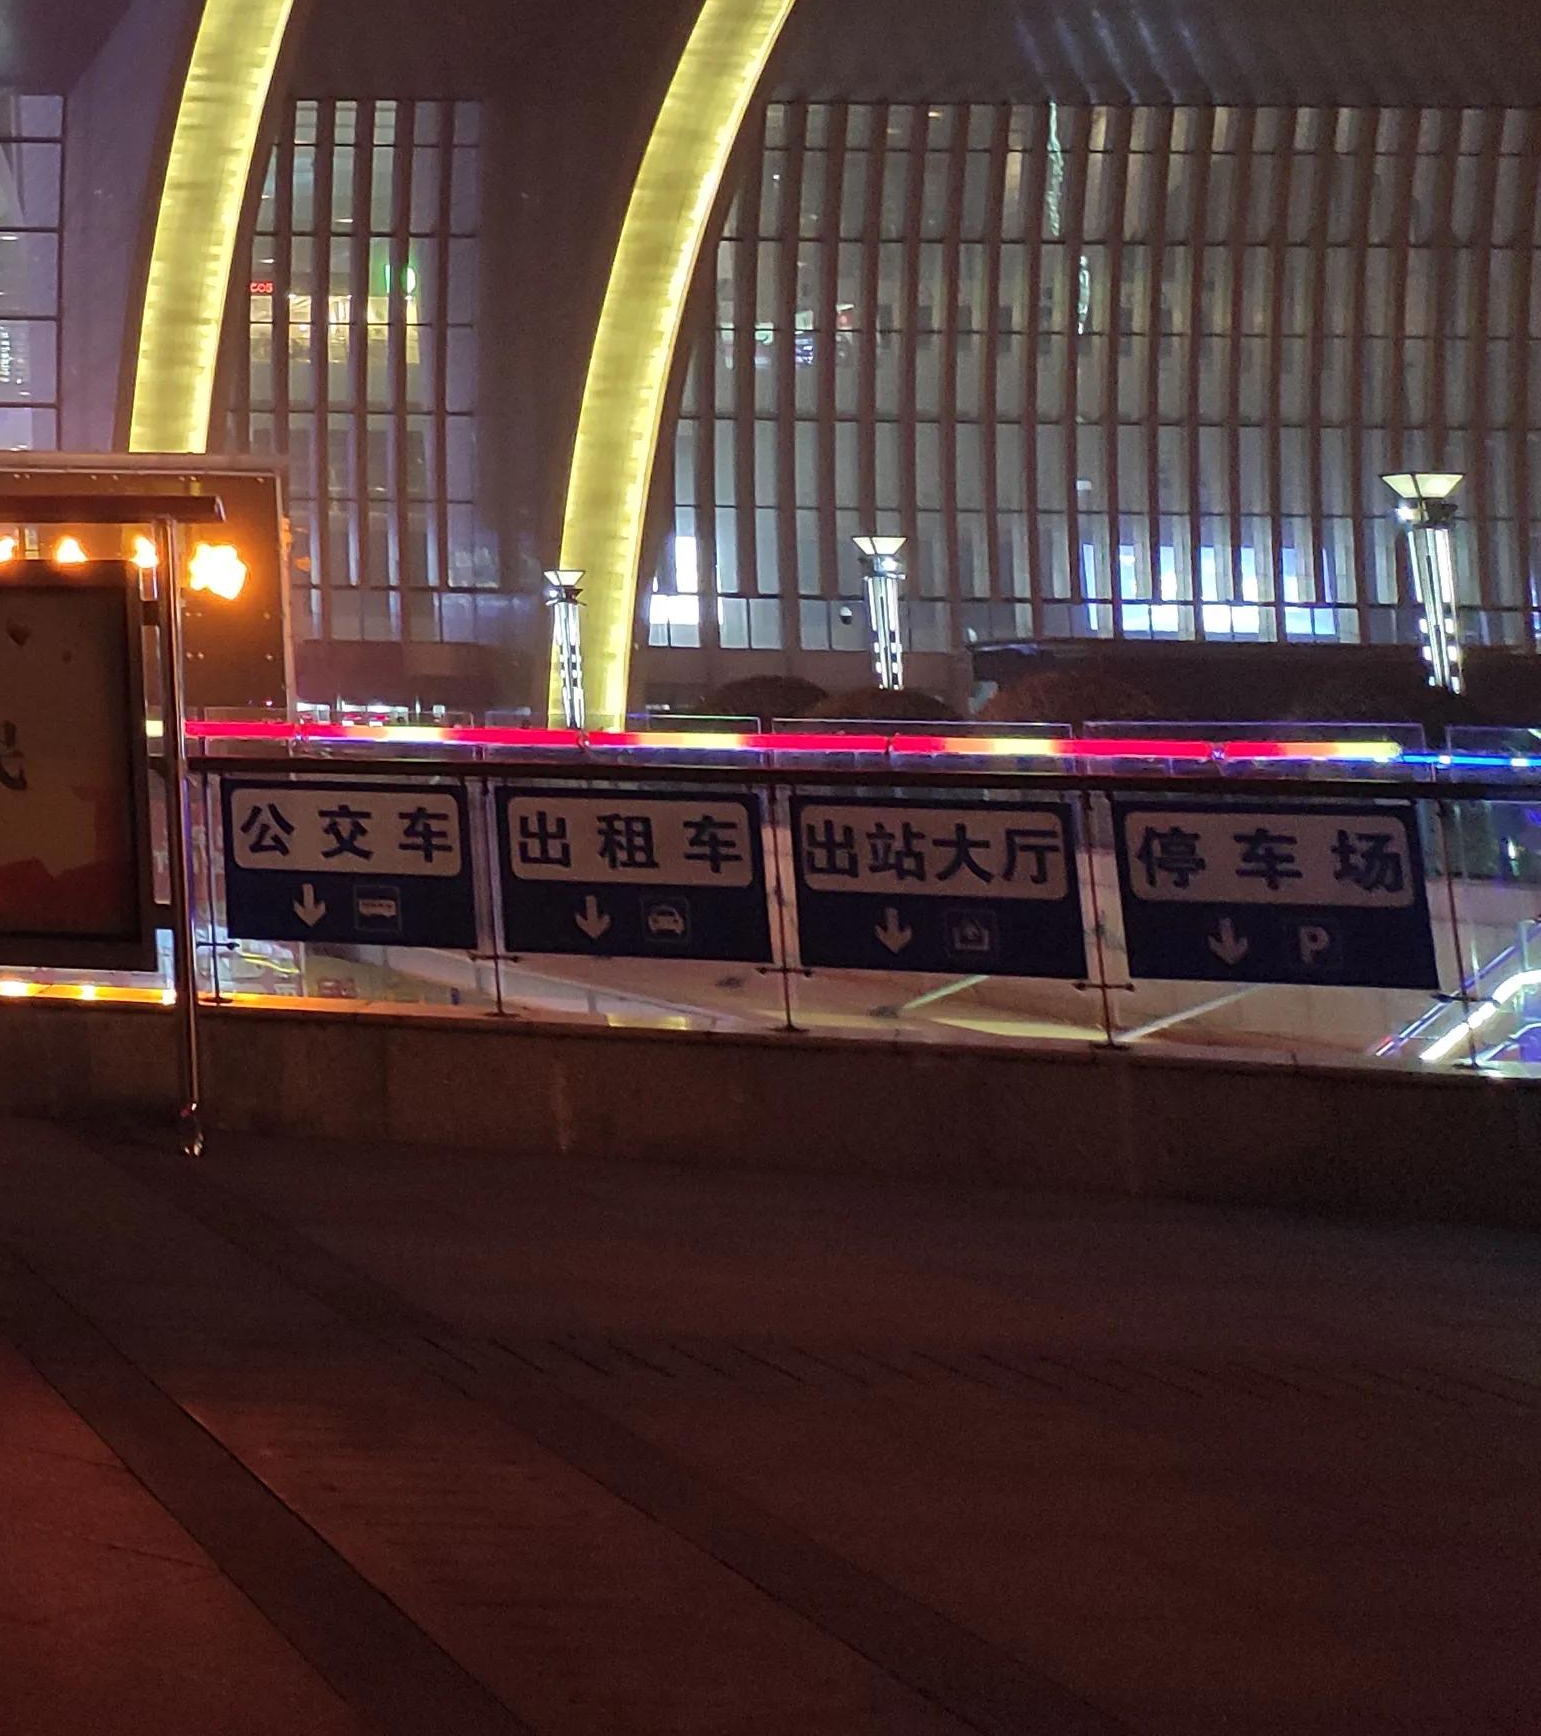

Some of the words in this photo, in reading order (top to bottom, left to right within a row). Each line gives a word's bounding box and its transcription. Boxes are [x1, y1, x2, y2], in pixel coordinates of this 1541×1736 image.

[239, 802, 454, 864] 公交车
[517, 810, 744, 875] 出租车
[804, 819, 1064, 887] 出站大厅
[1136, 825, 1406, 895] 停车场
